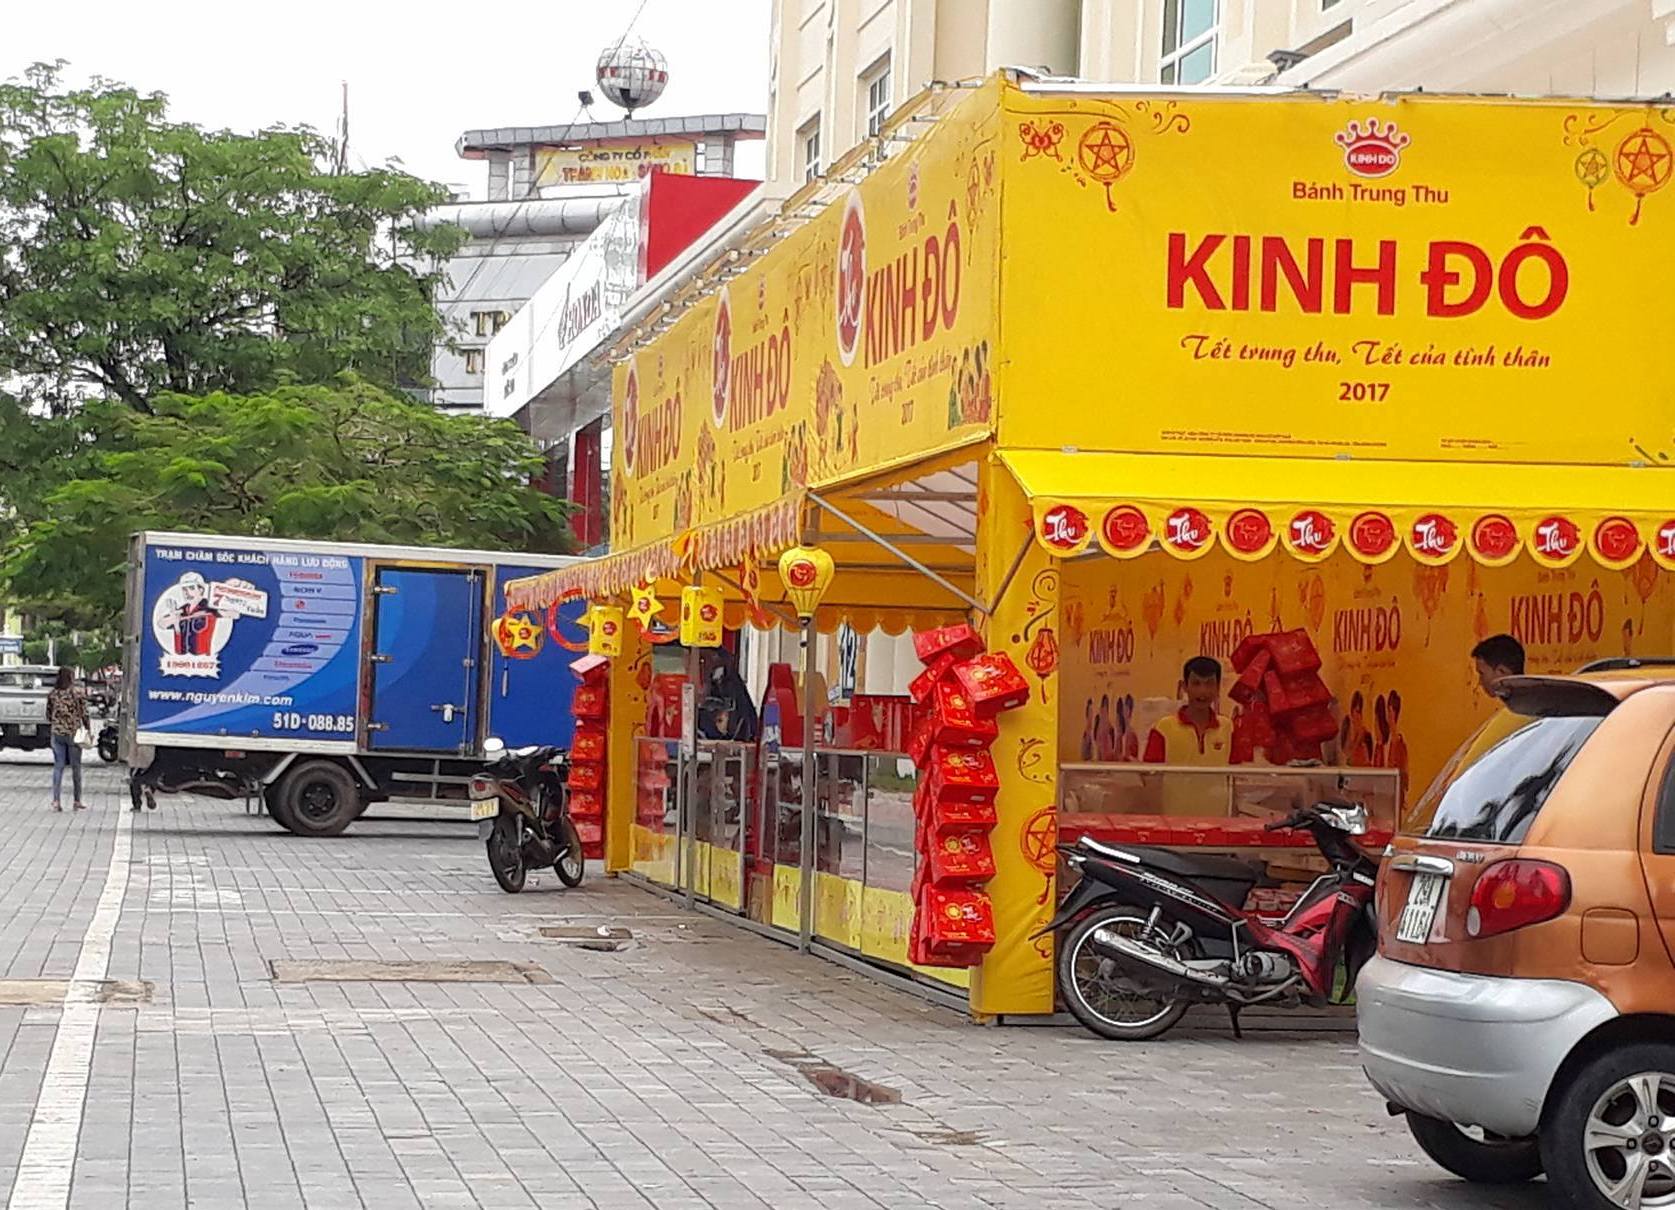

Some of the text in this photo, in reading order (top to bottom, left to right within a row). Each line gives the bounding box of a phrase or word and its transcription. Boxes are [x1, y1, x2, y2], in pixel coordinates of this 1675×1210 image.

[1350, 153, 1378, 165] KINH
[1292, 181, 1449, 207] Bánh Trung Thu
[864, 199, 960, 370] KINH ĐÔ
[1166, 226, 1569, 320] KINH ĐÔ
[1180, 334, 1551, 369] Tết trung thu, Tết của tình thân
[729, 341, 766, 434] KINH
[767, 307, 791, 417] ĐÔ
[1338, 382, 1391, 402] 2017
[1045, 510, 1082, 544] Thu
[1167, 511, 1206, 547] Thu
[1291, 514, 1330, 550] Thu
[1413, 519, 1453, 553] Thu
[1537, 521, 1574, 555] Thu
[1333, 595, 1400, 653] KINH ĐÔ
[1511, 578, 1604, 645] KINH ĐÔ
[148, 689, 294, 706] www.nguyenkim.com
